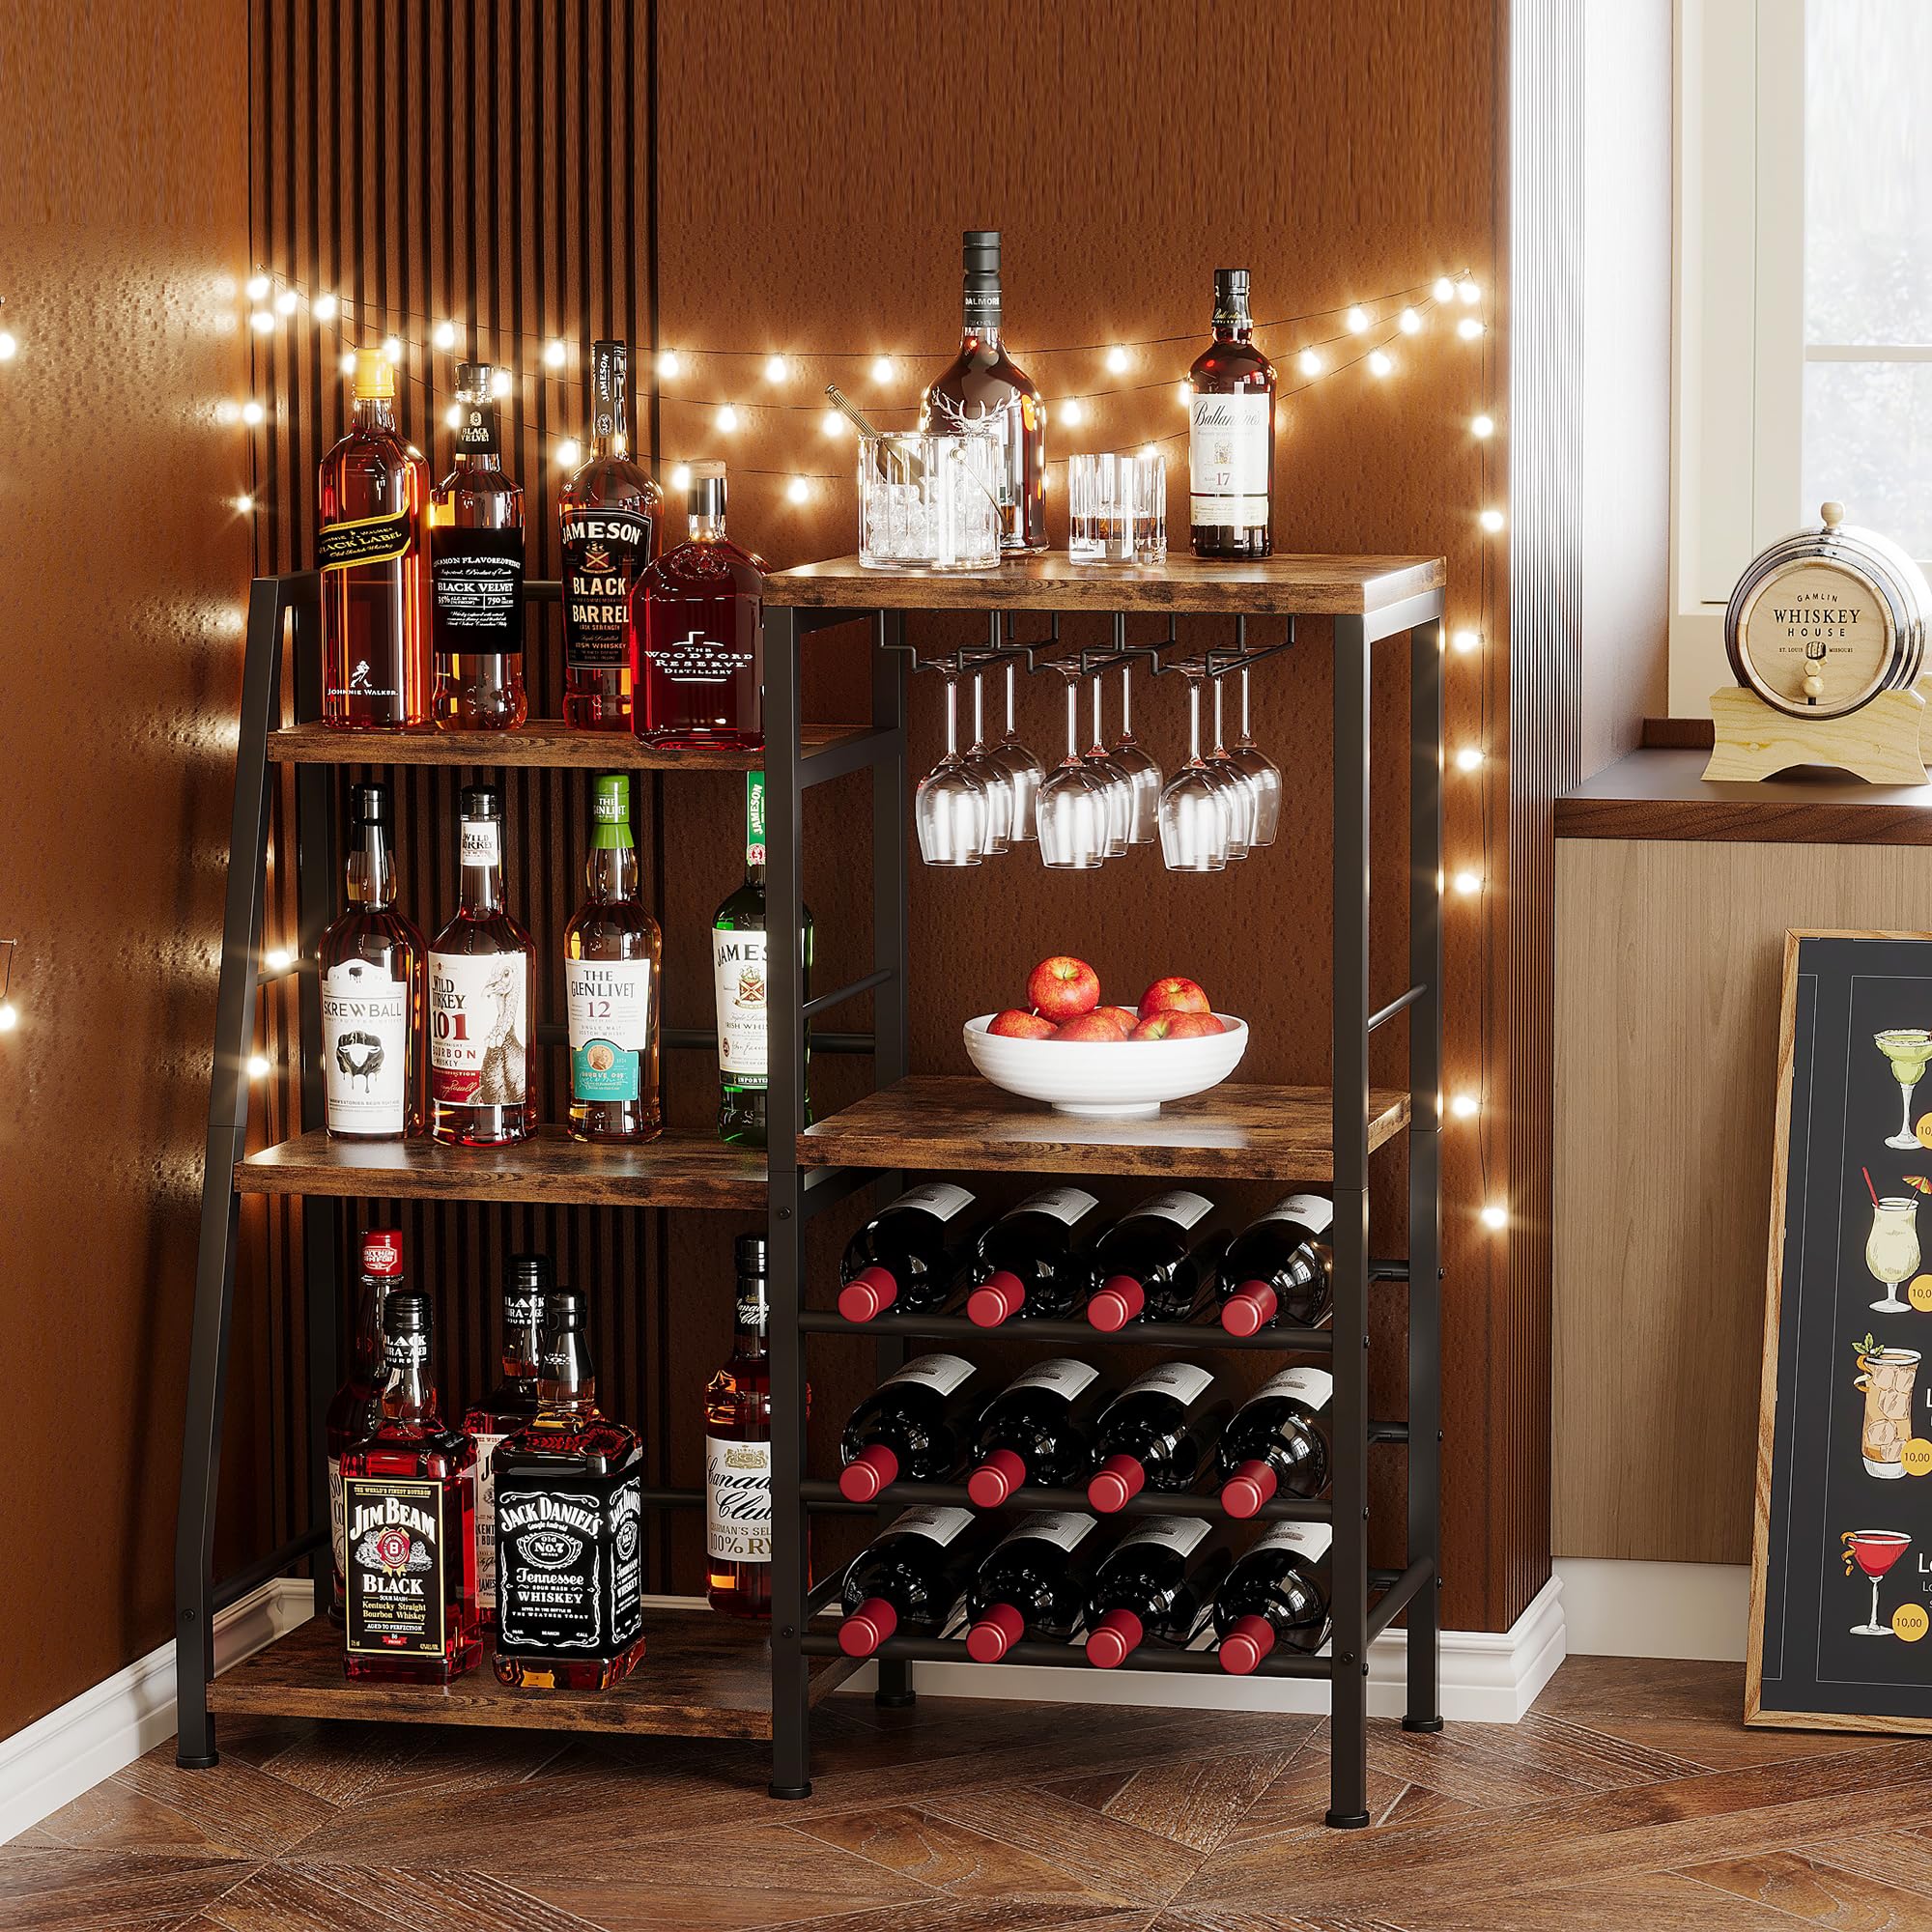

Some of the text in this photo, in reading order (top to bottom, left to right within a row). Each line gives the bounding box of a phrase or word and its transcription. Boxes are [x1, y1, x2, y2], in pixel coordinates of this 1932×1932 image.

[600, 354, 611, 402] JAMESON
[1193, 400, 1261, 426] Ballanne's
[1216, 472, 1231, 486] 17
[359, 531, 403, 545] LABEL
[562, 522, 641, 546] JAMESON
[438, 582, 514, 592] BLACK VELVET
[573, 577, 626, 595] BLACK
[487, 597, 502, 606] 750
[1797, 593, 1838, 603] GAMLIN
[572, 605, 630, 623] BARREL
[1773, 609, 1861, 624] WHISKEY
[1787, 628, 1845, 638] HOUSE
[644, 650, 753, 660] WOODFORD
[751, 783, 763, 836] JAMESON
[463, 833, 490, 841] WILD
[463, 840, 493, 850] URKEY
[583, 970, 613, 981] THE
[432, 975, 455, 993] WILD
[571, 980, 635, 999] GLENLIVET
[324, 1001, 402, 1017] SKREWBALL
[587, 1001, 611, 1018] 12
[432, 1010, 470, 1040] 101
[386, 1335, 427, 1346] LACK
[1904, 1452, 1930, 1463] 10,00
[350, 1497, 437, 1546] JIM BEAM
[499, 1496, 605, 1537] JACK DANIEL'S
[389, 1542, 399, 1554] B
[534, 1543, 565, 1553] No.7
[711, 1532, 744, 1555] 100%
[516, 1567, 584, 1585] Tennessee
[362, 1574, 425, 1595] BLACK
[517, 1591, 583, 1604] WHISKEY
[362, 1601, 427, 1612] Kentucky Straight
[362, 1609, 426, 1622] Bourbon Whiskey
[1896, 1617, 1922, 1629] 10,00
